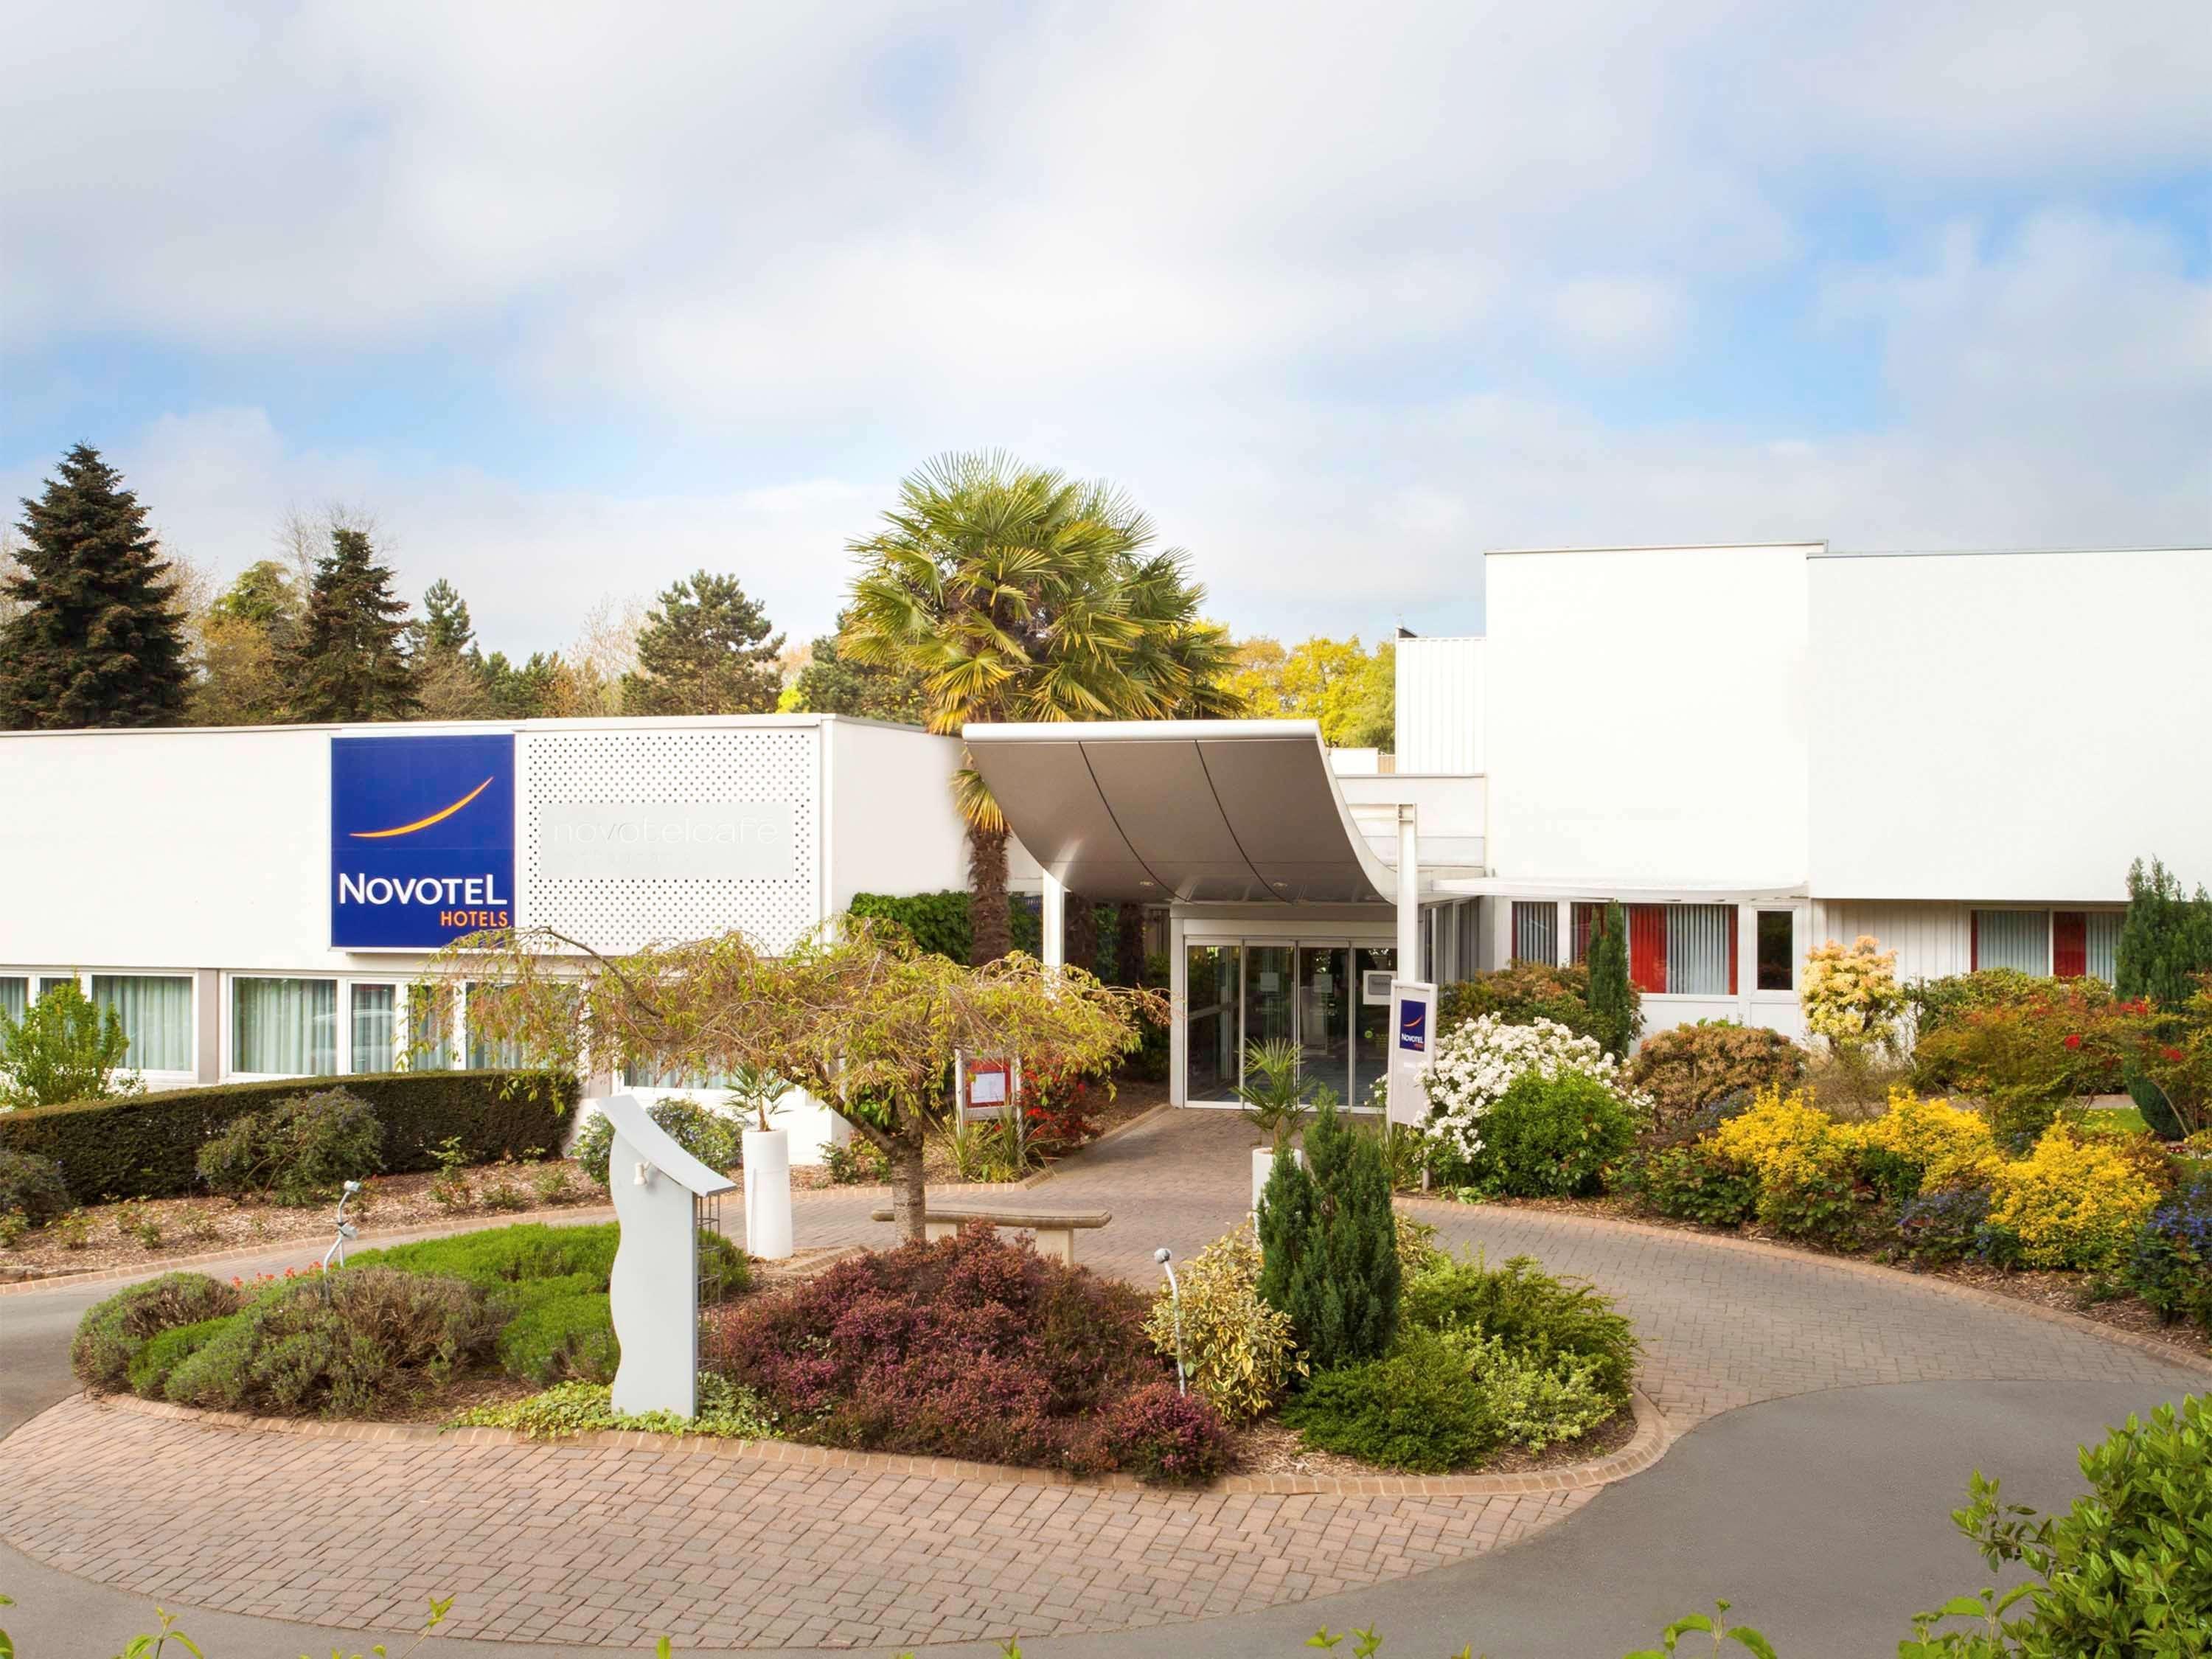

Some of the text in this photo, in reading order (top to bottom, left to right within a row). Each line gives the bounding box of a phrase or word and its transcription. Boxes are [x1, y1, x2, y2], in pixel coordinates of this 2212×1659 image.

[339, 874, 507, 905] NOVOTEL
[440, 911, 508, 928] HOTELS
[1402, 1033, 1423, 1044] NOVOTEL
